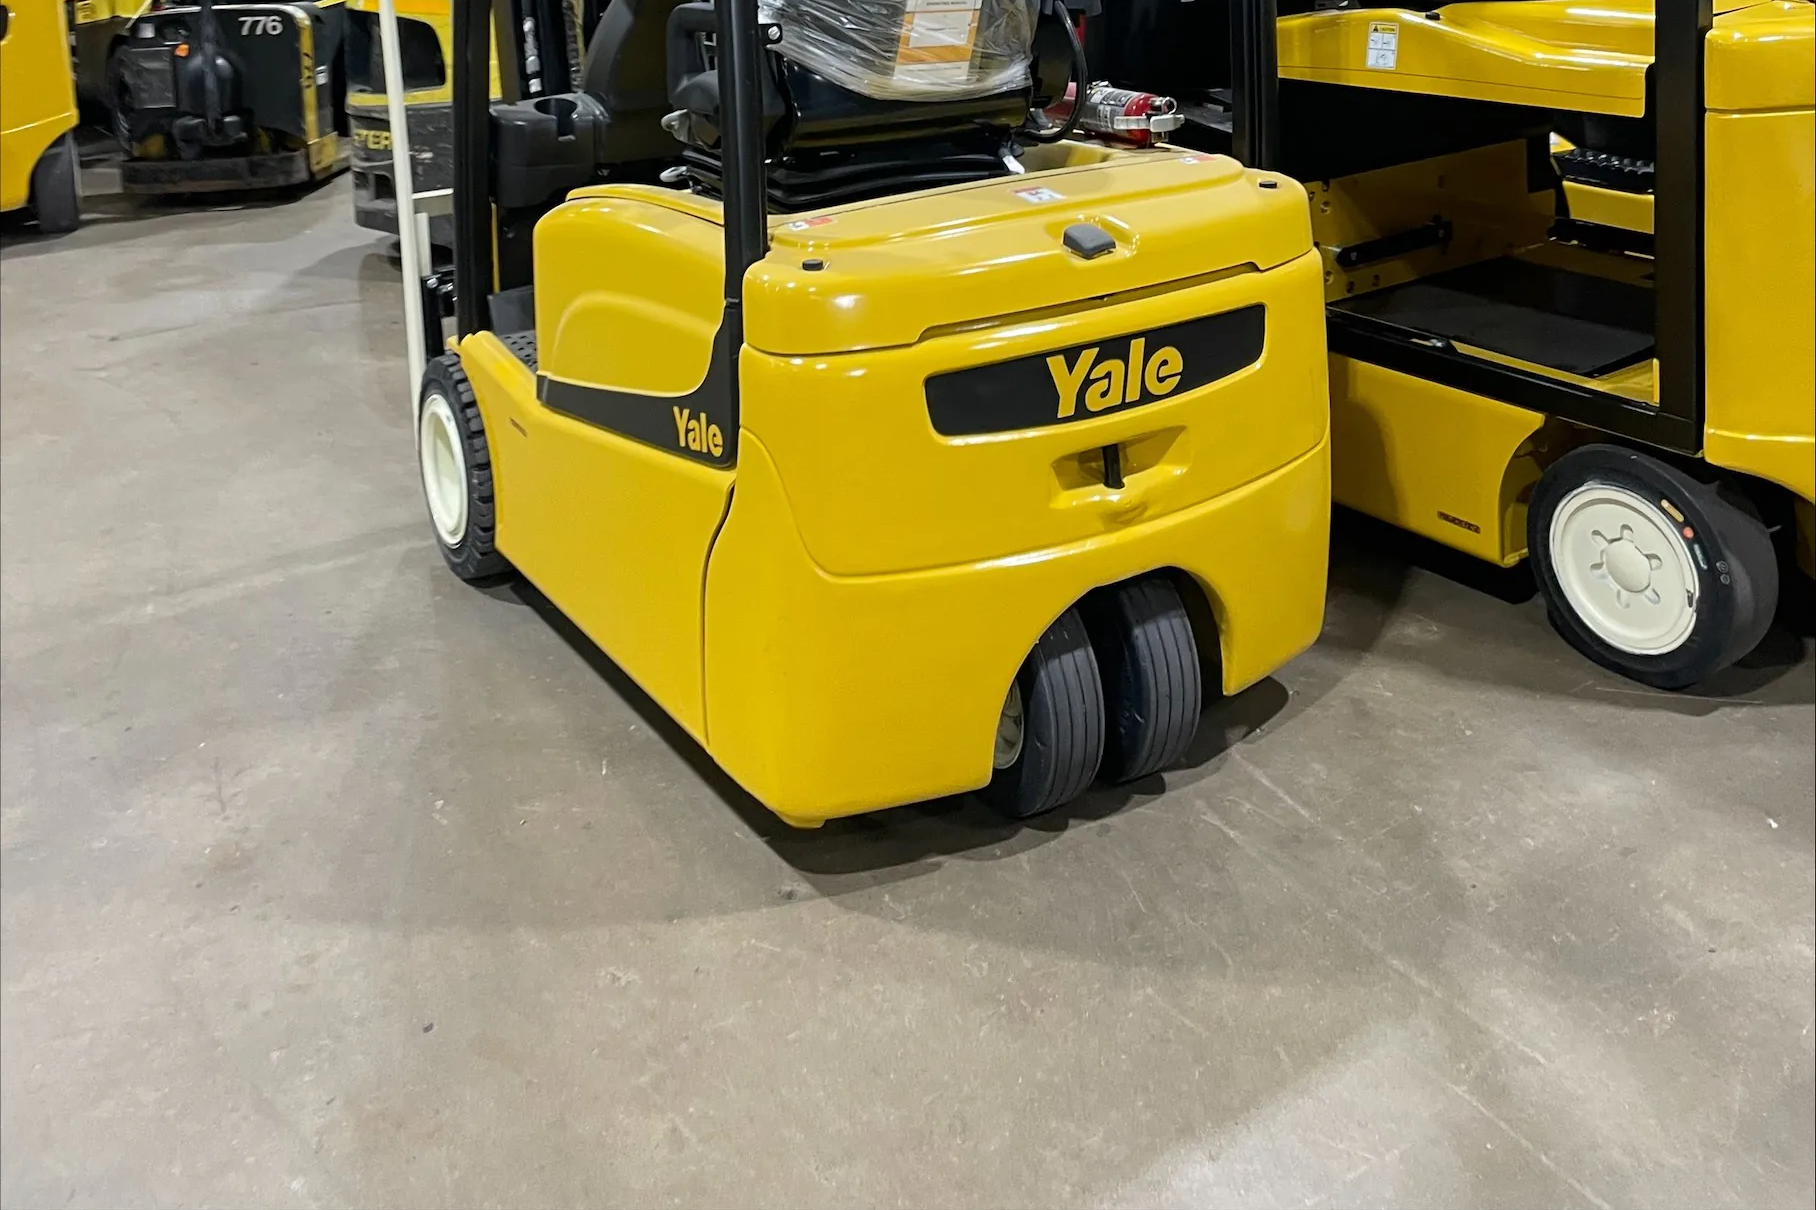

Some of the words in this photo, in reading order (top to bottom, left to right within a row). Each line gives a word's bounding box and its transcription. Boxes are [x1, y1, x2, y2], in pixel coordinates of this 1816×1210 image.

[238, 15, 283, 35] 776
[1046, 337, 1183, 418] Yale
[672, 405, 723, 458] Yale
